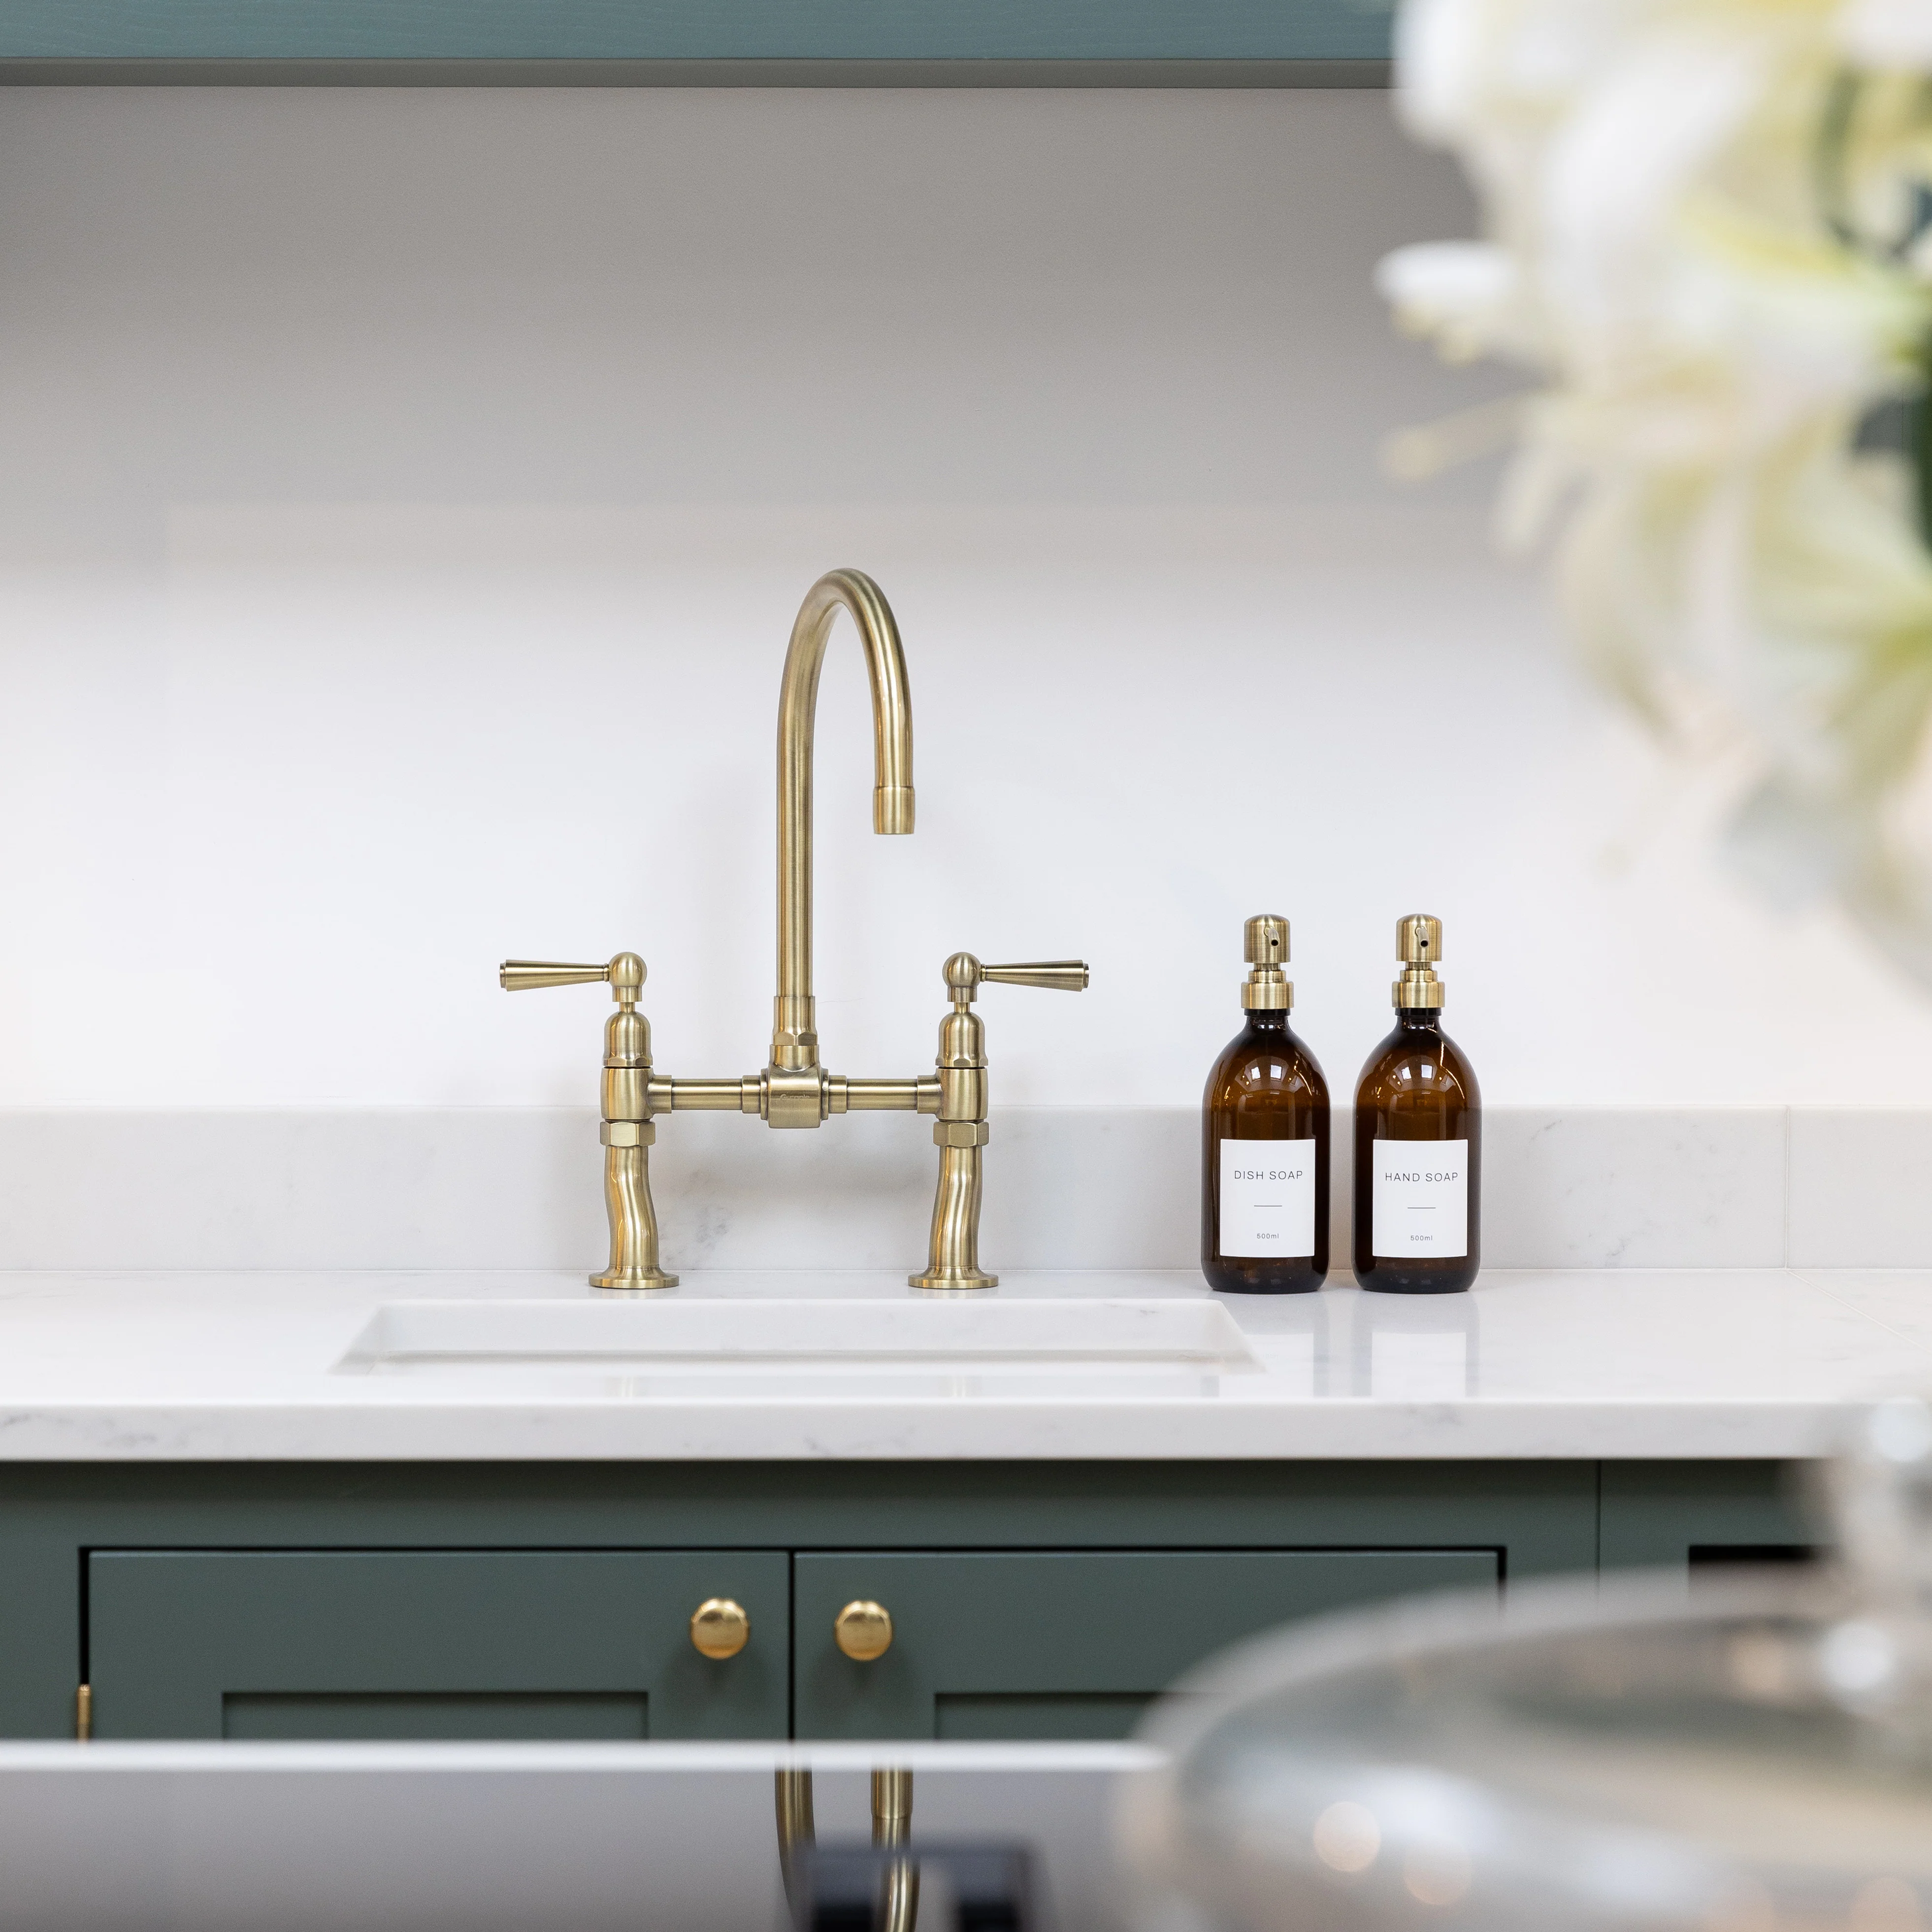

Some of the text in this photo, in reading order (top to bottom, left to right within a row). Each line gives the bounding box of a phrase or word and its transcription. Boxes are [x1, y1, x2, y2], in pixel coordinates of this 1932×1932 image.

[1234, 1170, 1303, 1180] DISH SOAP
[1385, 1172, 1458, 1182] HAND SOAP
